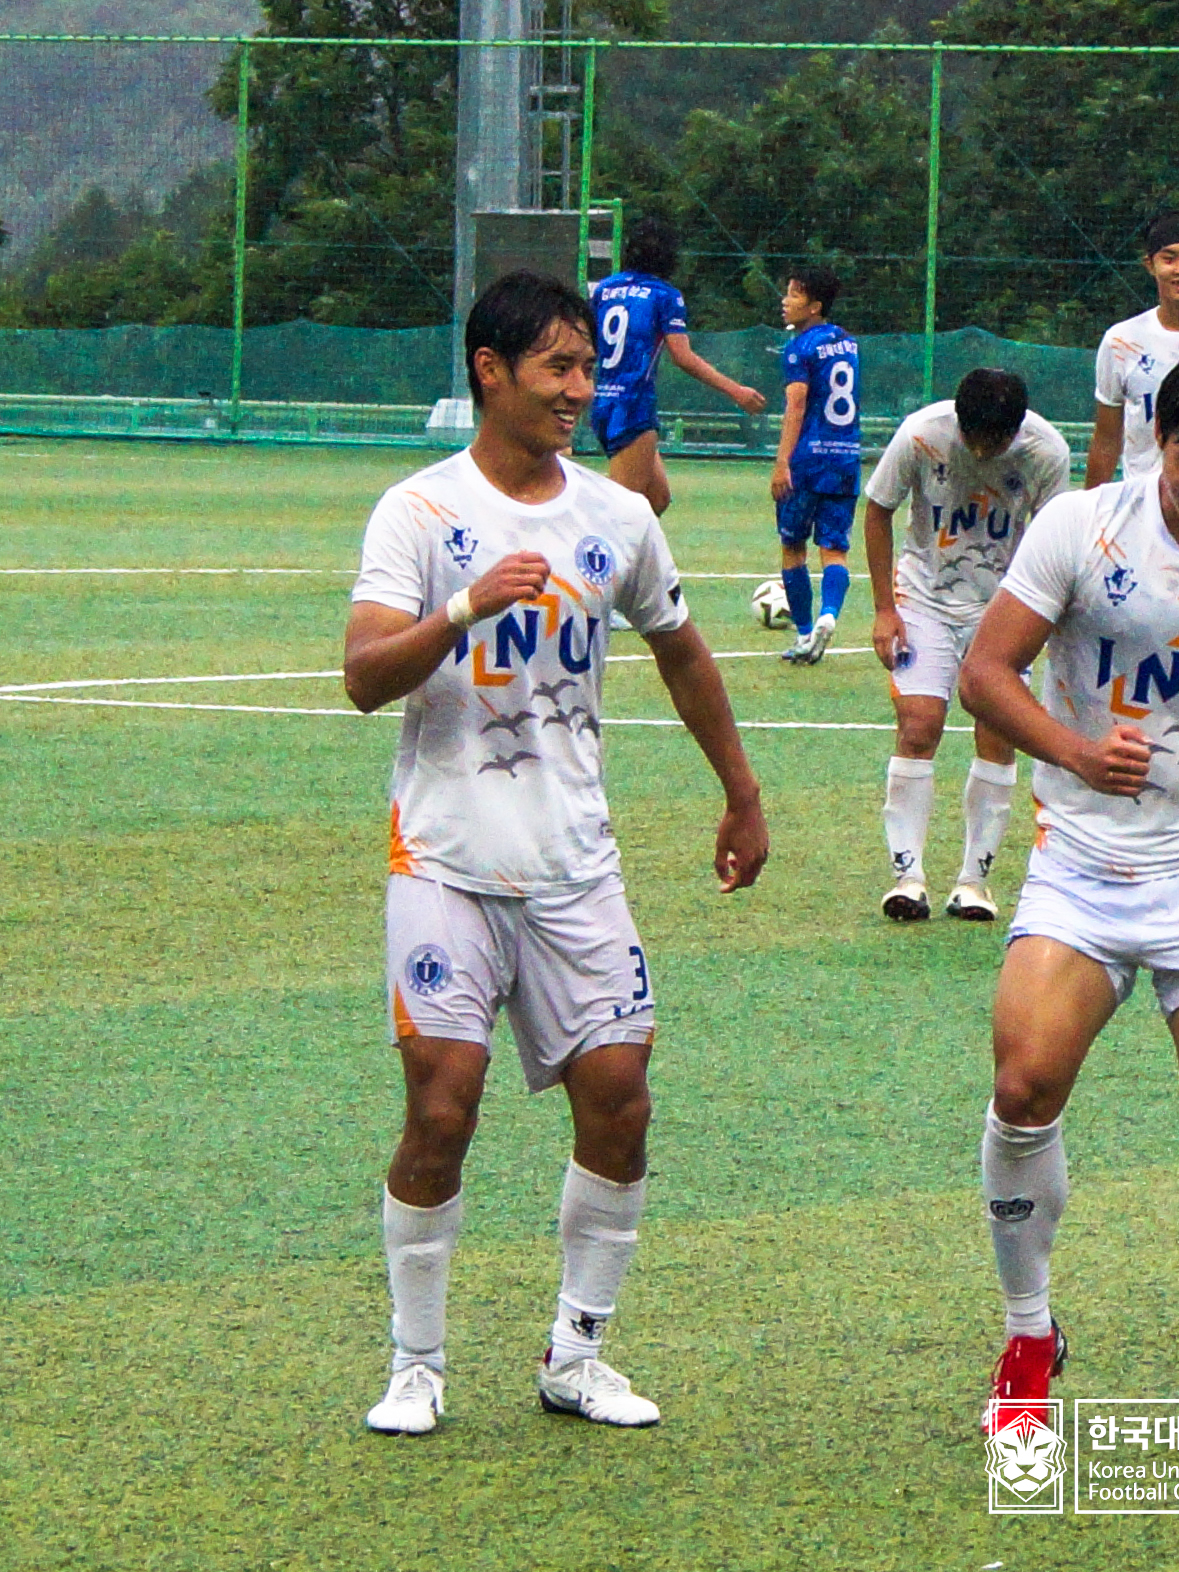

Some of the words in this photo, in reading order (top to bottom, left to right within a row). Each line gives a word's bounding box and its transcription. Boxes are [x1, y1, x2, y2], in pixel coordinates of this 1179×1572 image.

[602, 305, 629, 369] 9
[824, 361, 856, 426] 8
[932, 503, 1010, 540] INU
[628, 945, 649, 1001] 3
